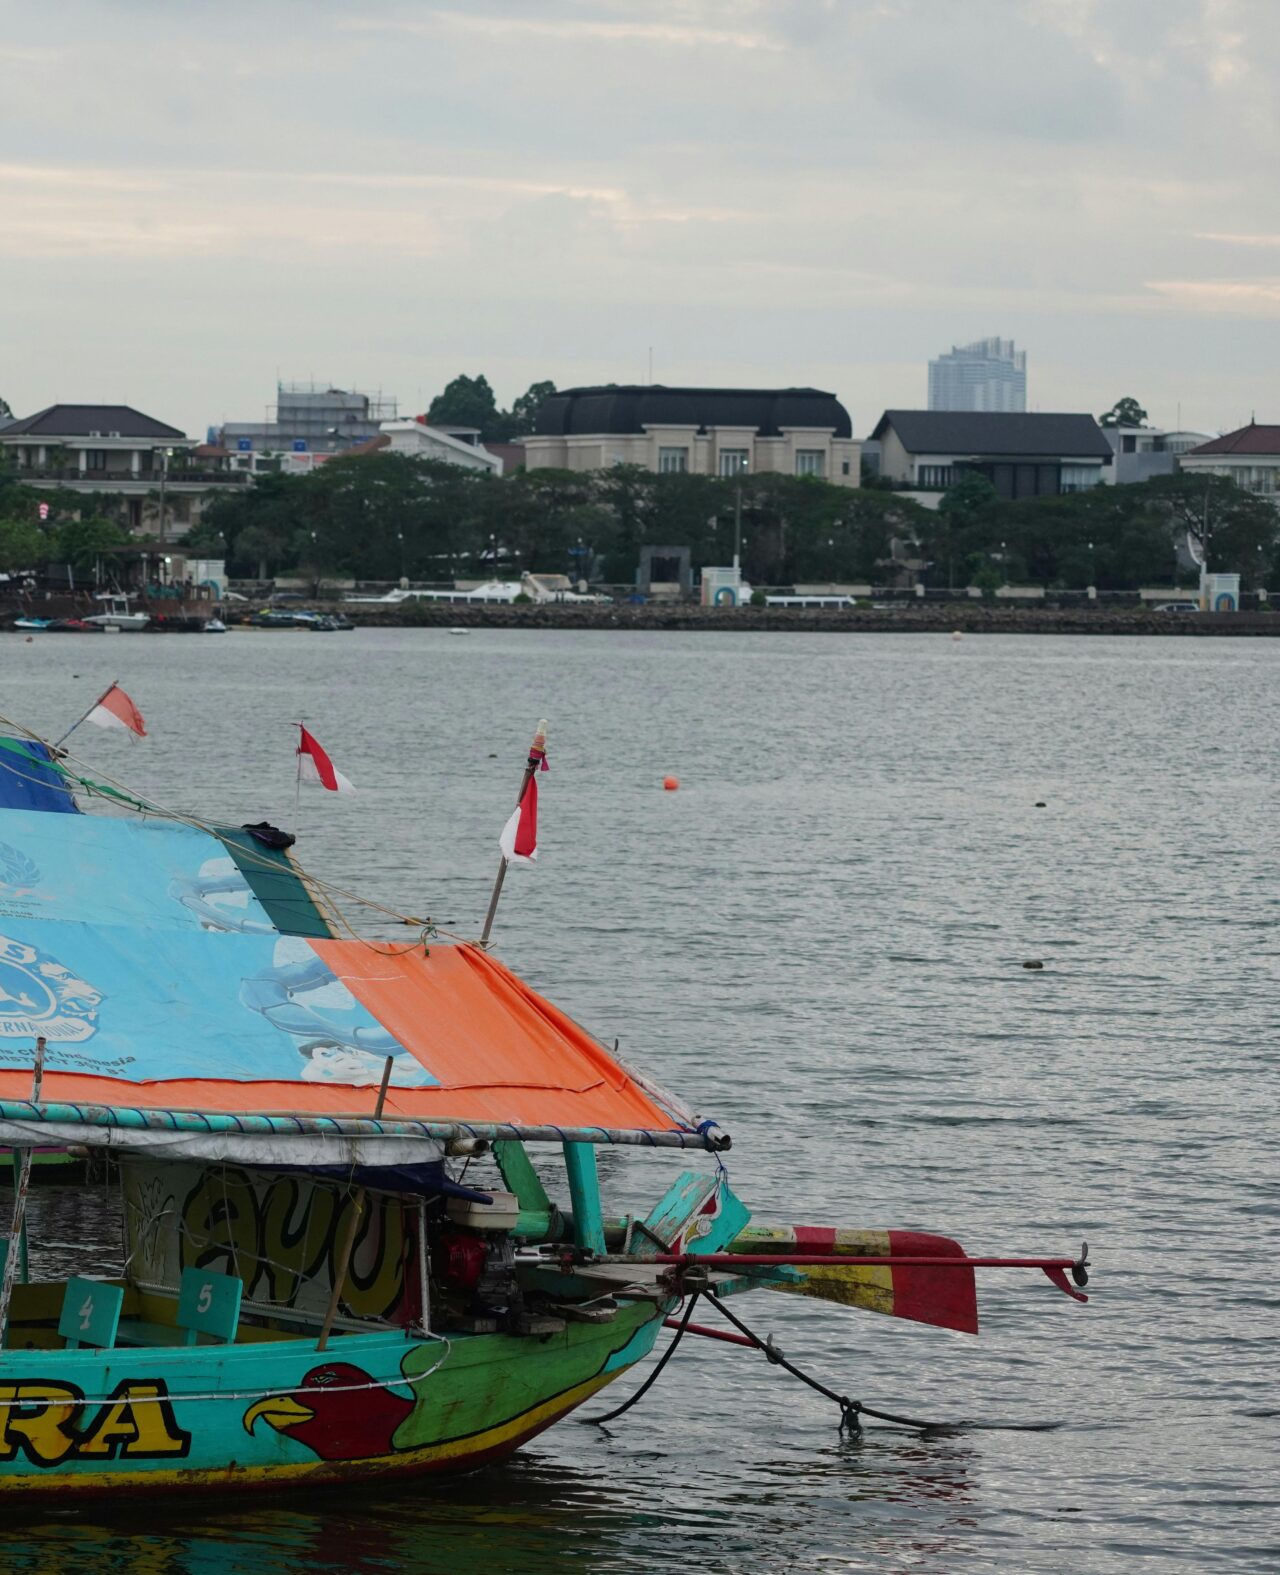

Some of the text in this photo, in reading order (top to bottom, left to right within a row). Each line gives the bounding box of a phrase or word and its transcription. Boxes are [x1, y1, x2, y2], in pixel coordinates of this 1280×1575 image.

[17, 1047, 54, 1057] Clb
[78, 1295, 95, 1331] 4
[196, 1283, 213, 1313] 5
